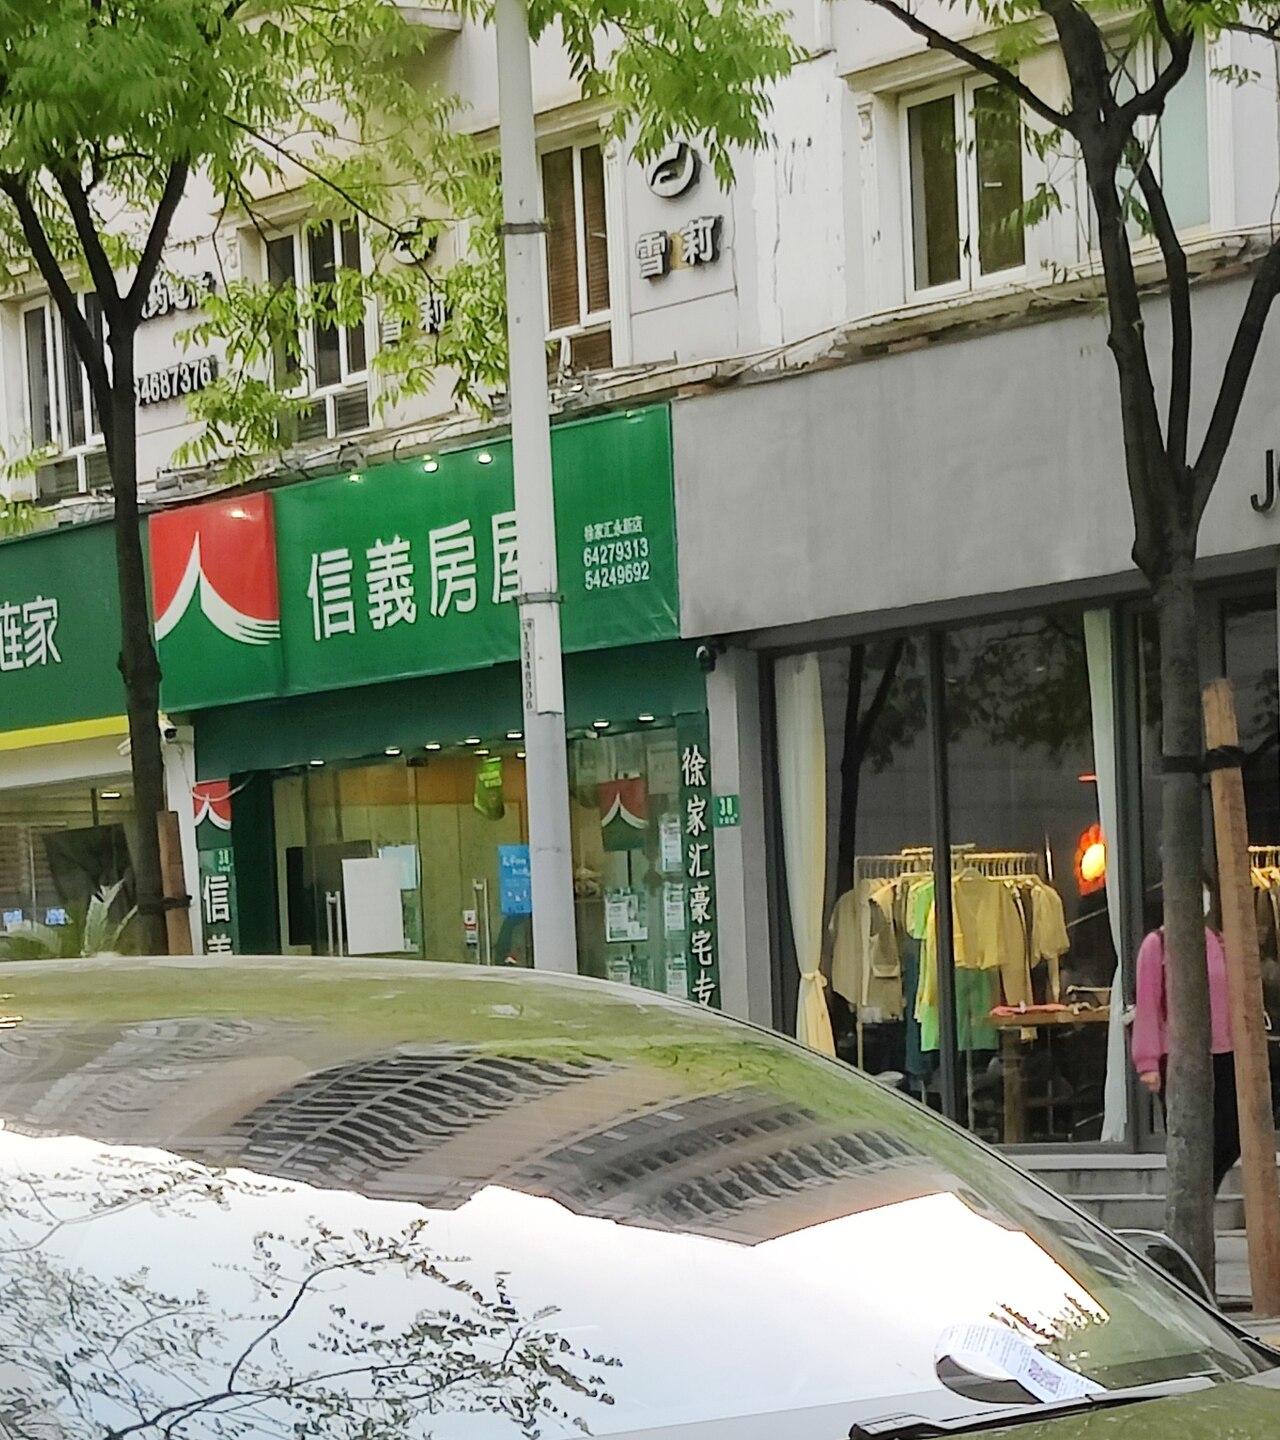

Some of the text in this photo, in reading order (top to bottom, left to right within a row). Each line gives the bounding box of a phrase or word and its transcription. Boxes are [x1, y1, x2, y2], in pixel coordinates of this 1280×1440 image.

[635, 216, 718, 279] 雪莉
[583, 537, 649, 567] 64279313
[585, 560, 650, 590] 54249692
